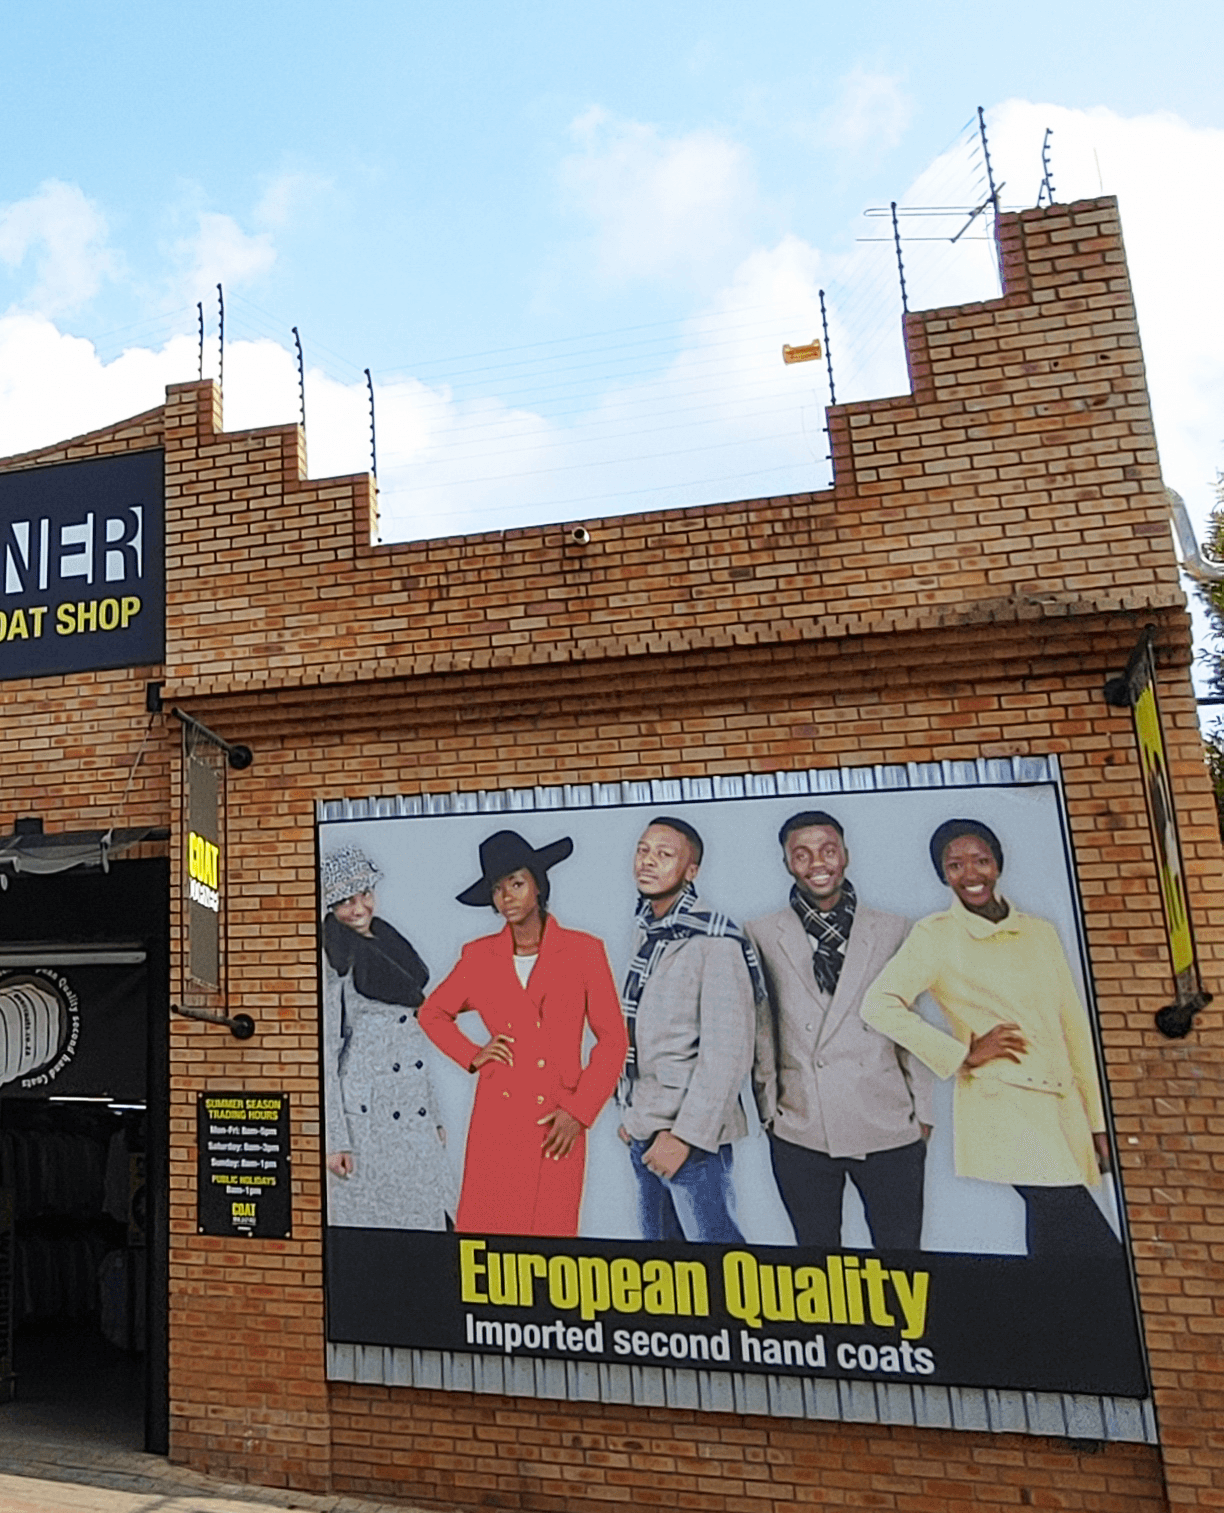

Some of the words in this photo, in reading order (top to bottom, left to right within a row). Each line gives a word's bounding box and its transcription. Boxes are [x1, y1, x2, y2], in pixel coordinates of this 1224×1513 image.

[56, 597, 142, 635] SHOP
[189, 831, 219, 890] COAT
[205, 1098, 244, 1109] SUMMER
[245, 1099, 281, 1110] SEASON
[208, 1109, 247, 1120] TRADING
[248, 1110, 279, 1121] HOURS
[211, 1174, 238, 1185] PUBLIC
[458, 1239, 710, 1320] European
[722, 1250, 930, 1340] Quality
[465, 1313, 604, 1353] Imported
[613, 1326, 731, 1363] second
[741, 1329, 826, 1369] hand
[836, 1340, 936, 1375] coats
